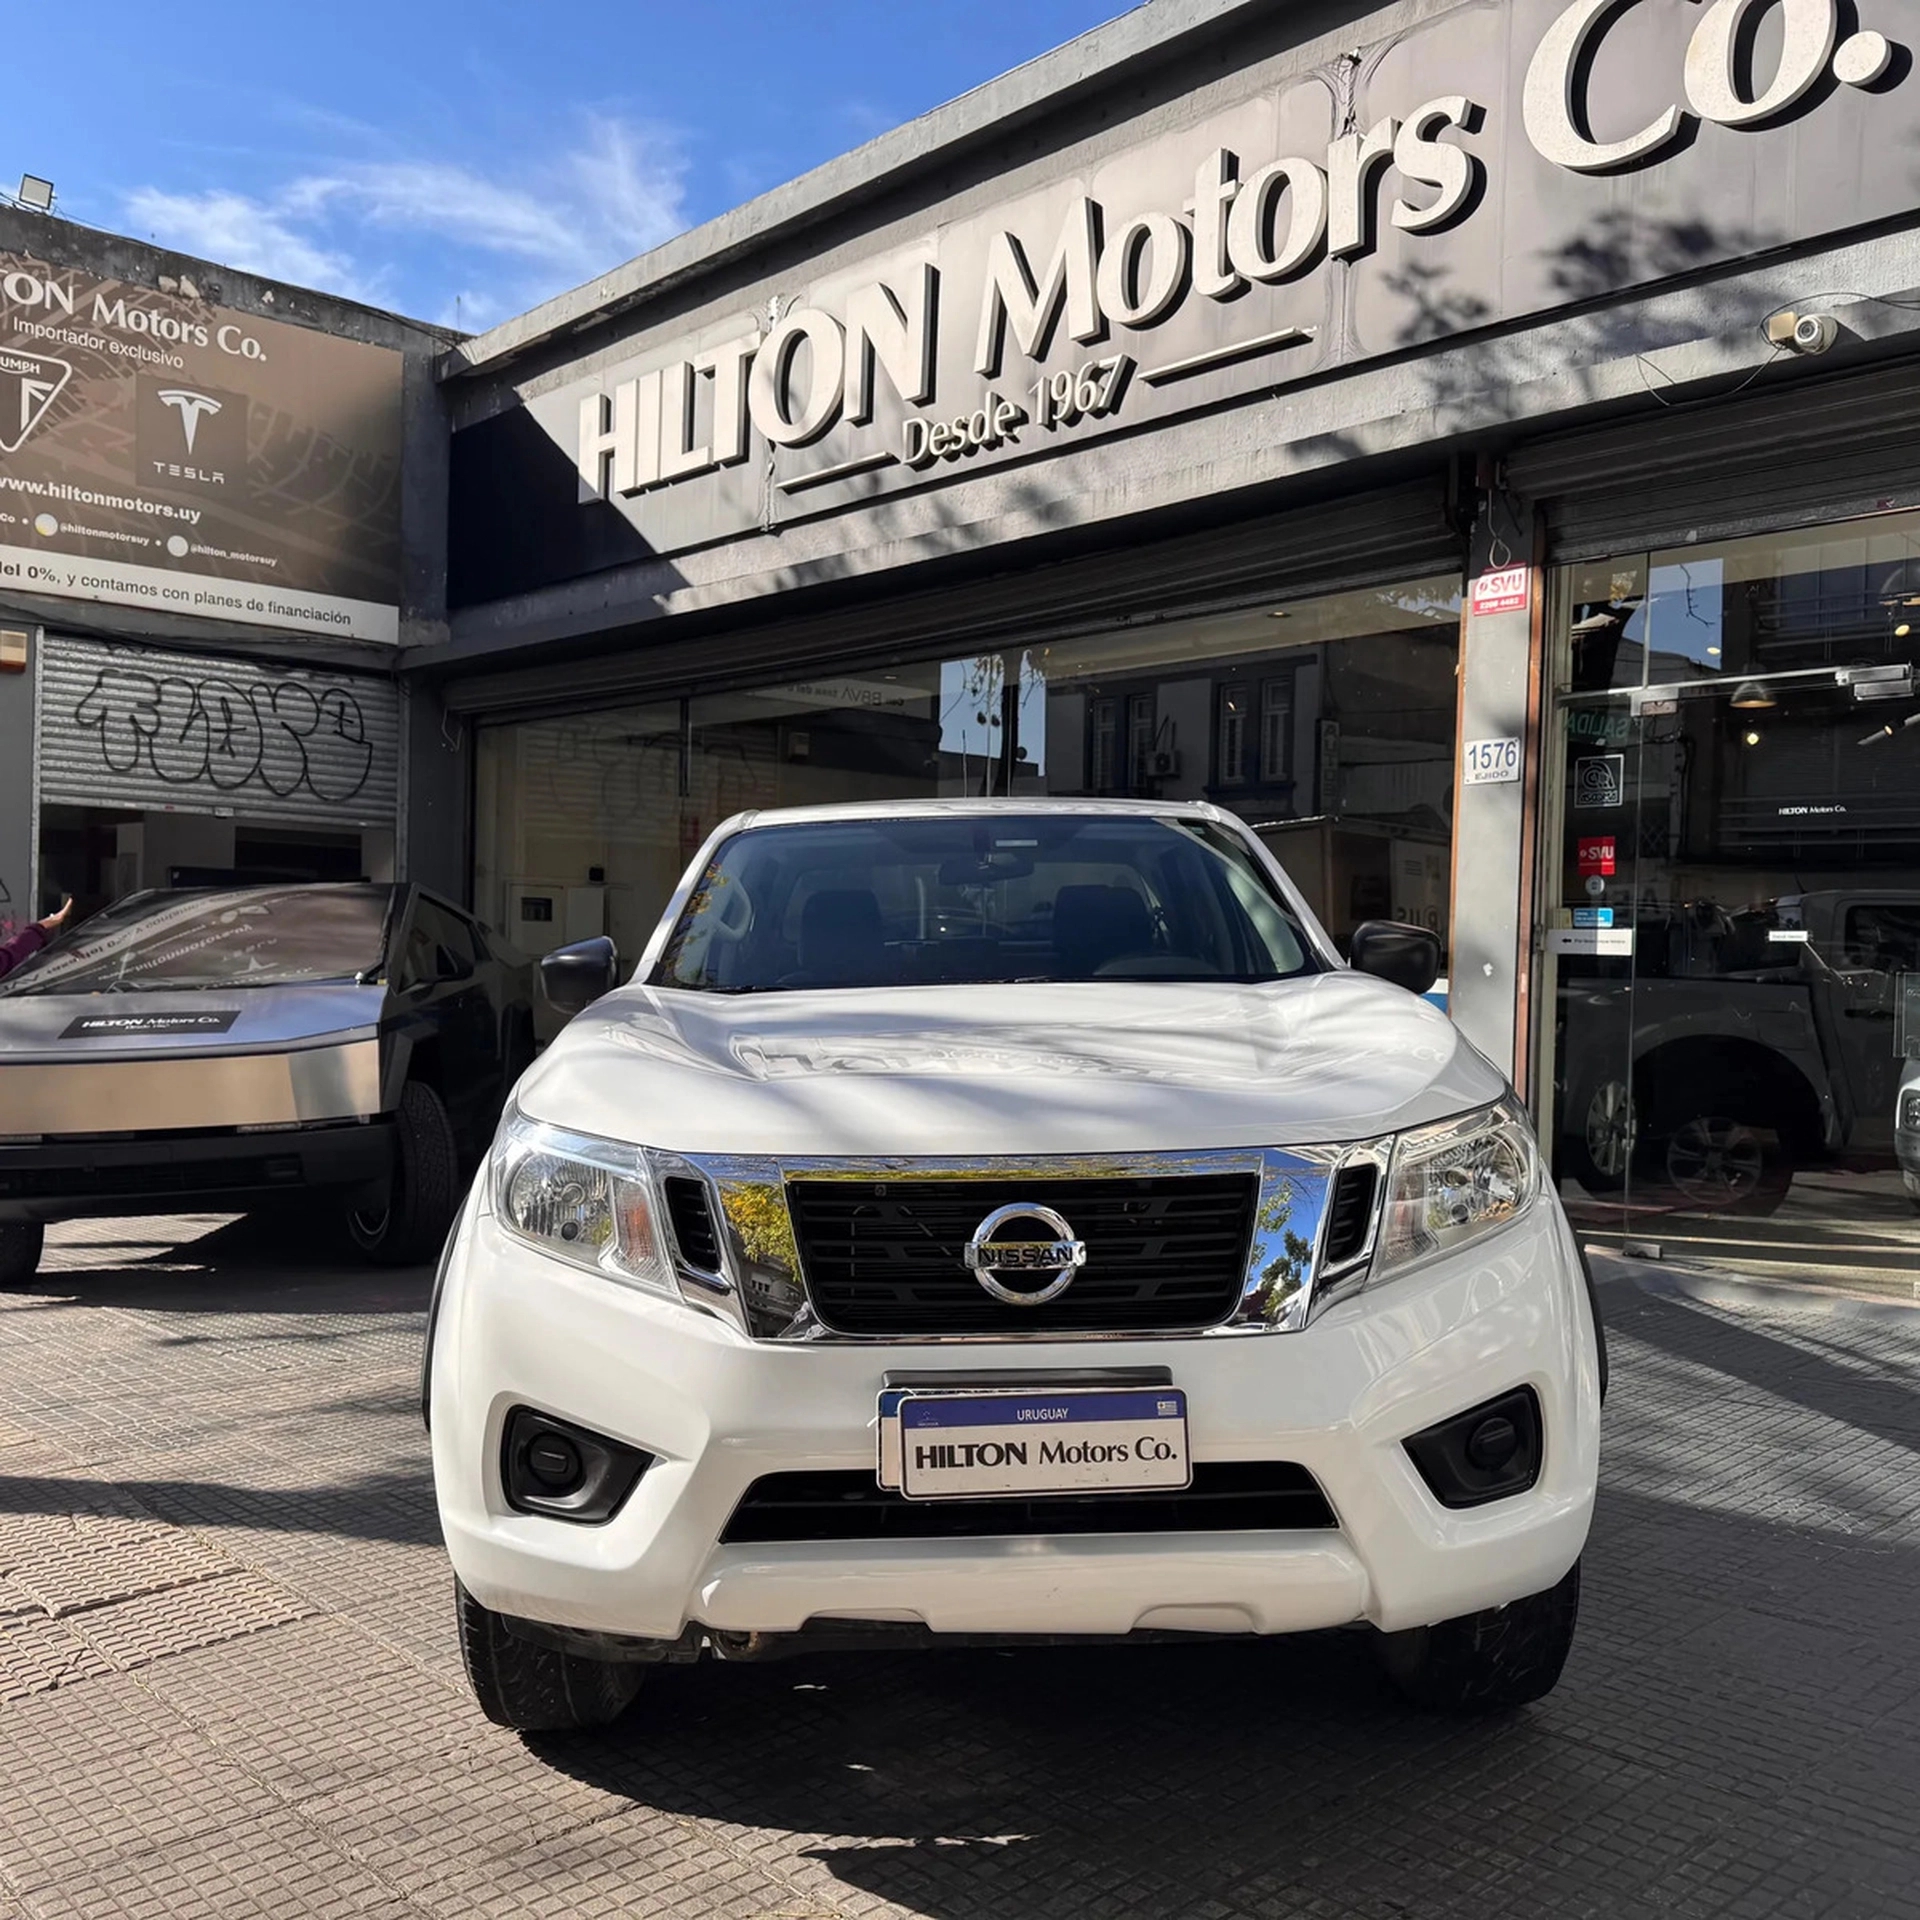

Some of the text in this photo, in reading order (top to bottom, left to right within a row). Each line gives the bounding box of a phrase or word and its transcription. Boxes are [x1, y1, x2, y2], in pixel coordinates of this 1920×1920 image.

[578, 0, 1898, 503] HILTON Motors Co.
[92, 294, 208, 348] Motors
[217, 325, 267, 361] Co.
[13, 316, 184, 369] Importador exclusivo
[902, 354, 1134, 467] Desde 1967
[153, 461, 225, 484] TESLA
[1490, 573, 1522, 593] SVU
[67, 574, 76, 587] y
[81, 576, 157, 596] contamos
[162, 587, 190, 601] con
[194, 591, 242, 608] planes
[246, 599, 264, 612] de
[268, 602, 351, 625] financiación
[1469, 741, 1516, 770] 1576
[1475, 770, 1509, 780] EJIDO
[1588, 846, 1614, 860] SVU
[81, 1018, 144, 1029] HILTON
[146, 1017, 195, 1025] Motors
[979, 1246, 1073, 1266] NISSAN
[1016, 1408, 1069, 1421] URUGUAY
[915, 1436, 1178, 1469] HILTON Motors Co.
